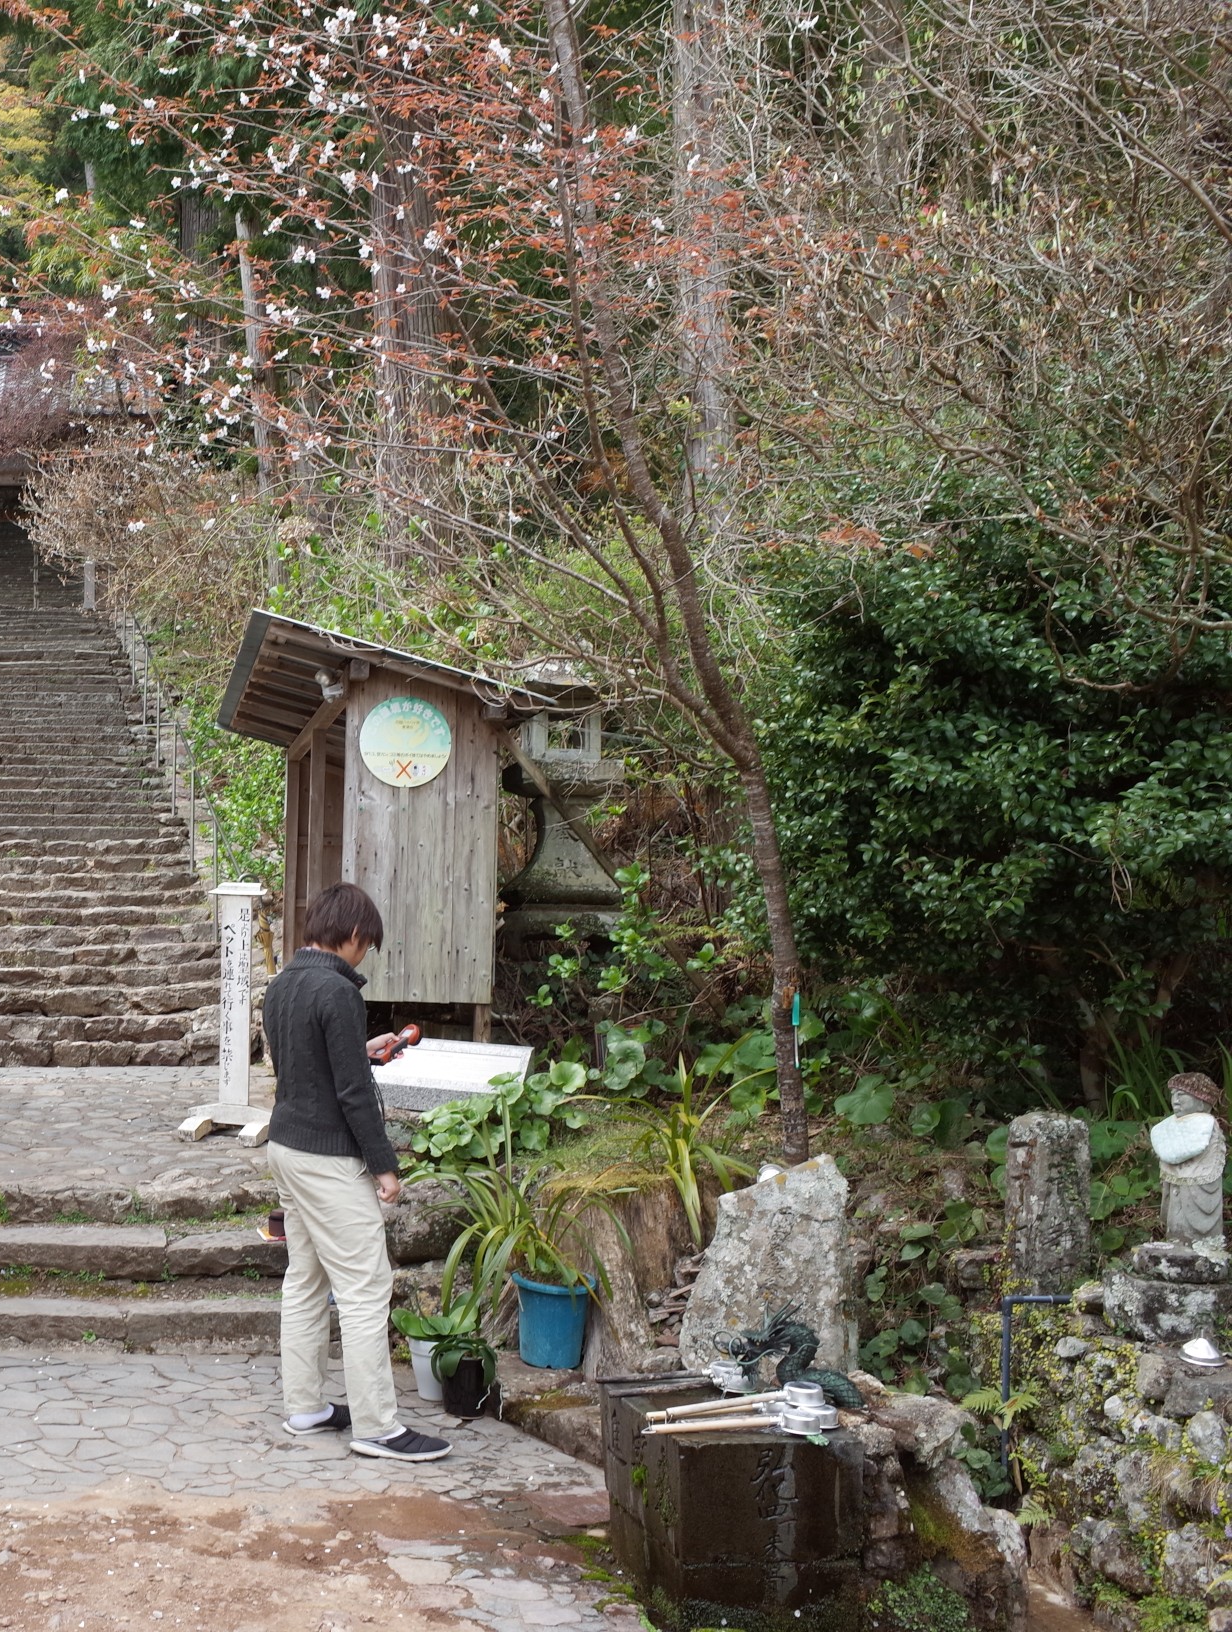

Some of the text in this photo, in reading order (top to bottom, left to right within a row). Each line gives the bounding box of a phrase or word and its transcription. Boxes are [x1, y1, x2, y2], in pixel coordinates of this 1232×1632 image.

[221, 923, 237, 1087] ペットを連れて行く事を禁じます
[237, 907, 251, 1005] 是より上は聖域です
